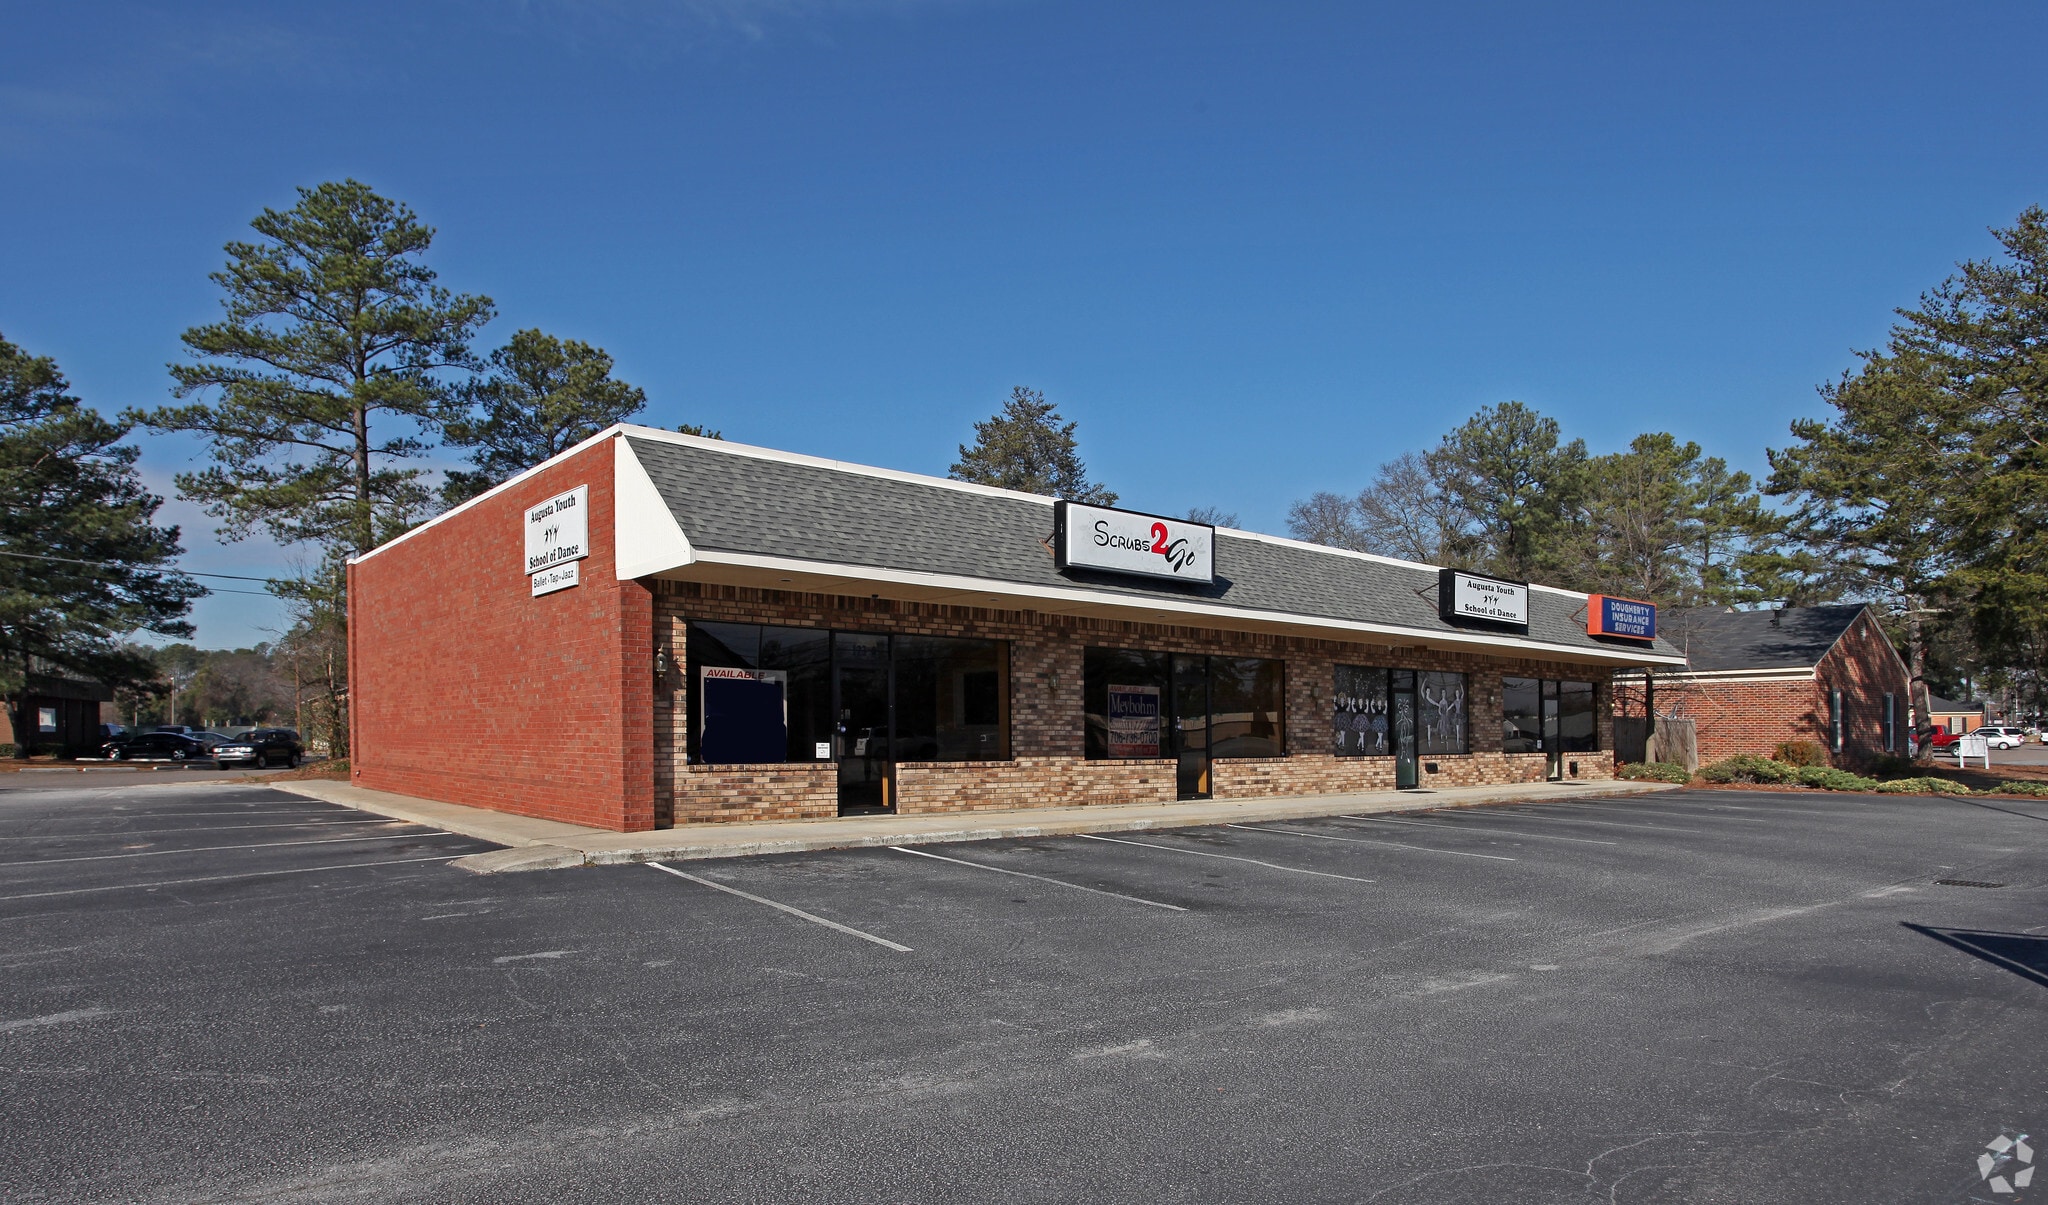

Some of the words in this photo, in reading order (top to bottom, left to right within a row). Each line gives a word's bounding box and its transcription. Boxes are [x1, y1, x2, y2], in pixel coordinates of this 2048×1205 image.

[531, 505, 554, 524] Augusta
[555, 494, 576, 513] Youth
[529, 551, 549, 569] School
[550, 548, 557, 562] of
[558, 544, 579, 560] Dance
[1164, 538, 1196, 573] Go
[533, 577, 547, 589] Ballet
[550, 573, 559, 584] Tap
[561, 569, 574, 580] Jazz
[1467, 580, 1495, 592] Augusta
[1496, 585, 1515, 596] Youth
[1464, 603, 1488, 615] School
[1497, 609, 1517, 619] Dance
[1611, 601, 1650, 616] DOUGHERTY
[1612, 612, 1650, 626] INSURANCE
[1614, 622, 1645, 635] SERVICES
[706, 669, 766, 680] AVAILABLE
[1110, 694, 1156, 717] Meybohm
